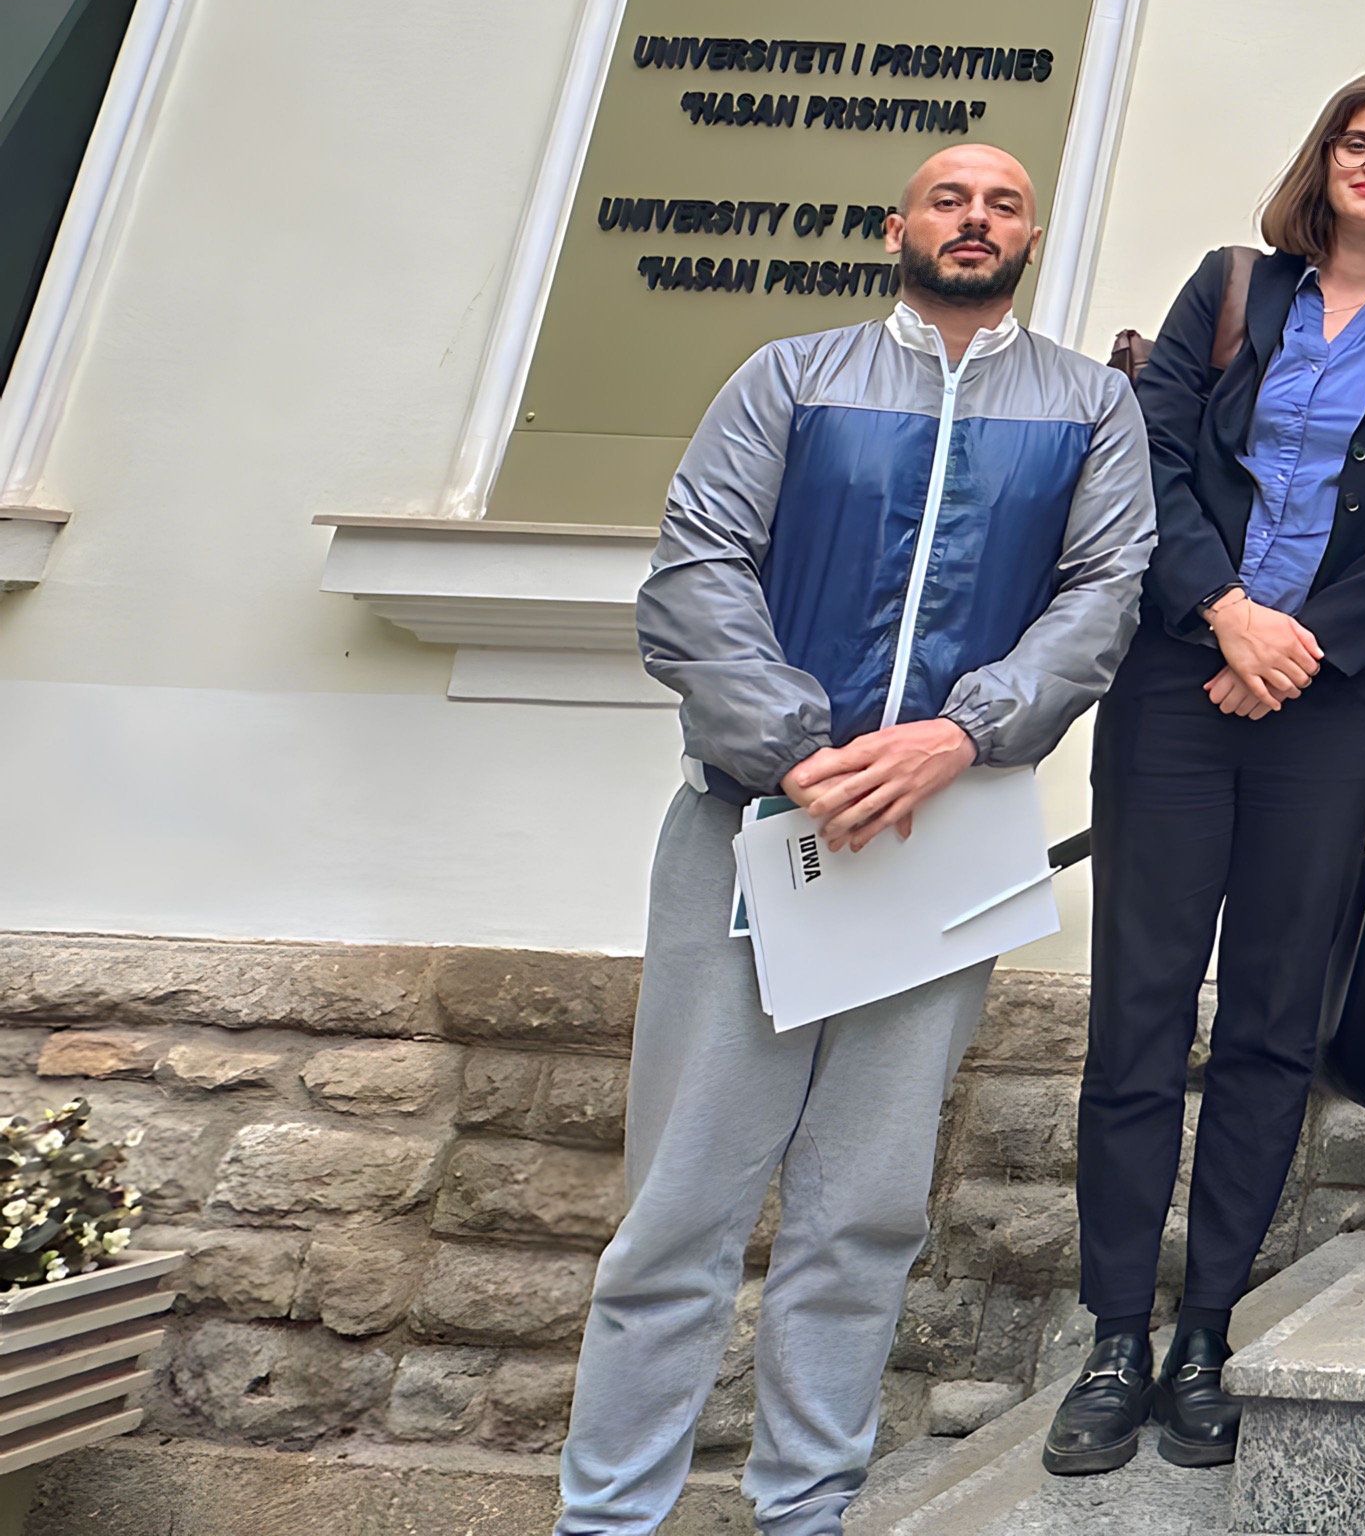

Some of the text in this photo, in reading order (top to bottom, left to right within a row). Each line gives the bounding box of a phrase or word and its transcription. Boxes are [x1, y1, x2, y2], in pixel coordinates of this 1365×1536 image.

[633, 35, 1054, 83] UNIVERSITETI I PRISHTINES
[597, 197, 790, 236] UNIVERSITY
[792, 202, 838, 239] OF
[799, 833, 822, 884] IOWA
